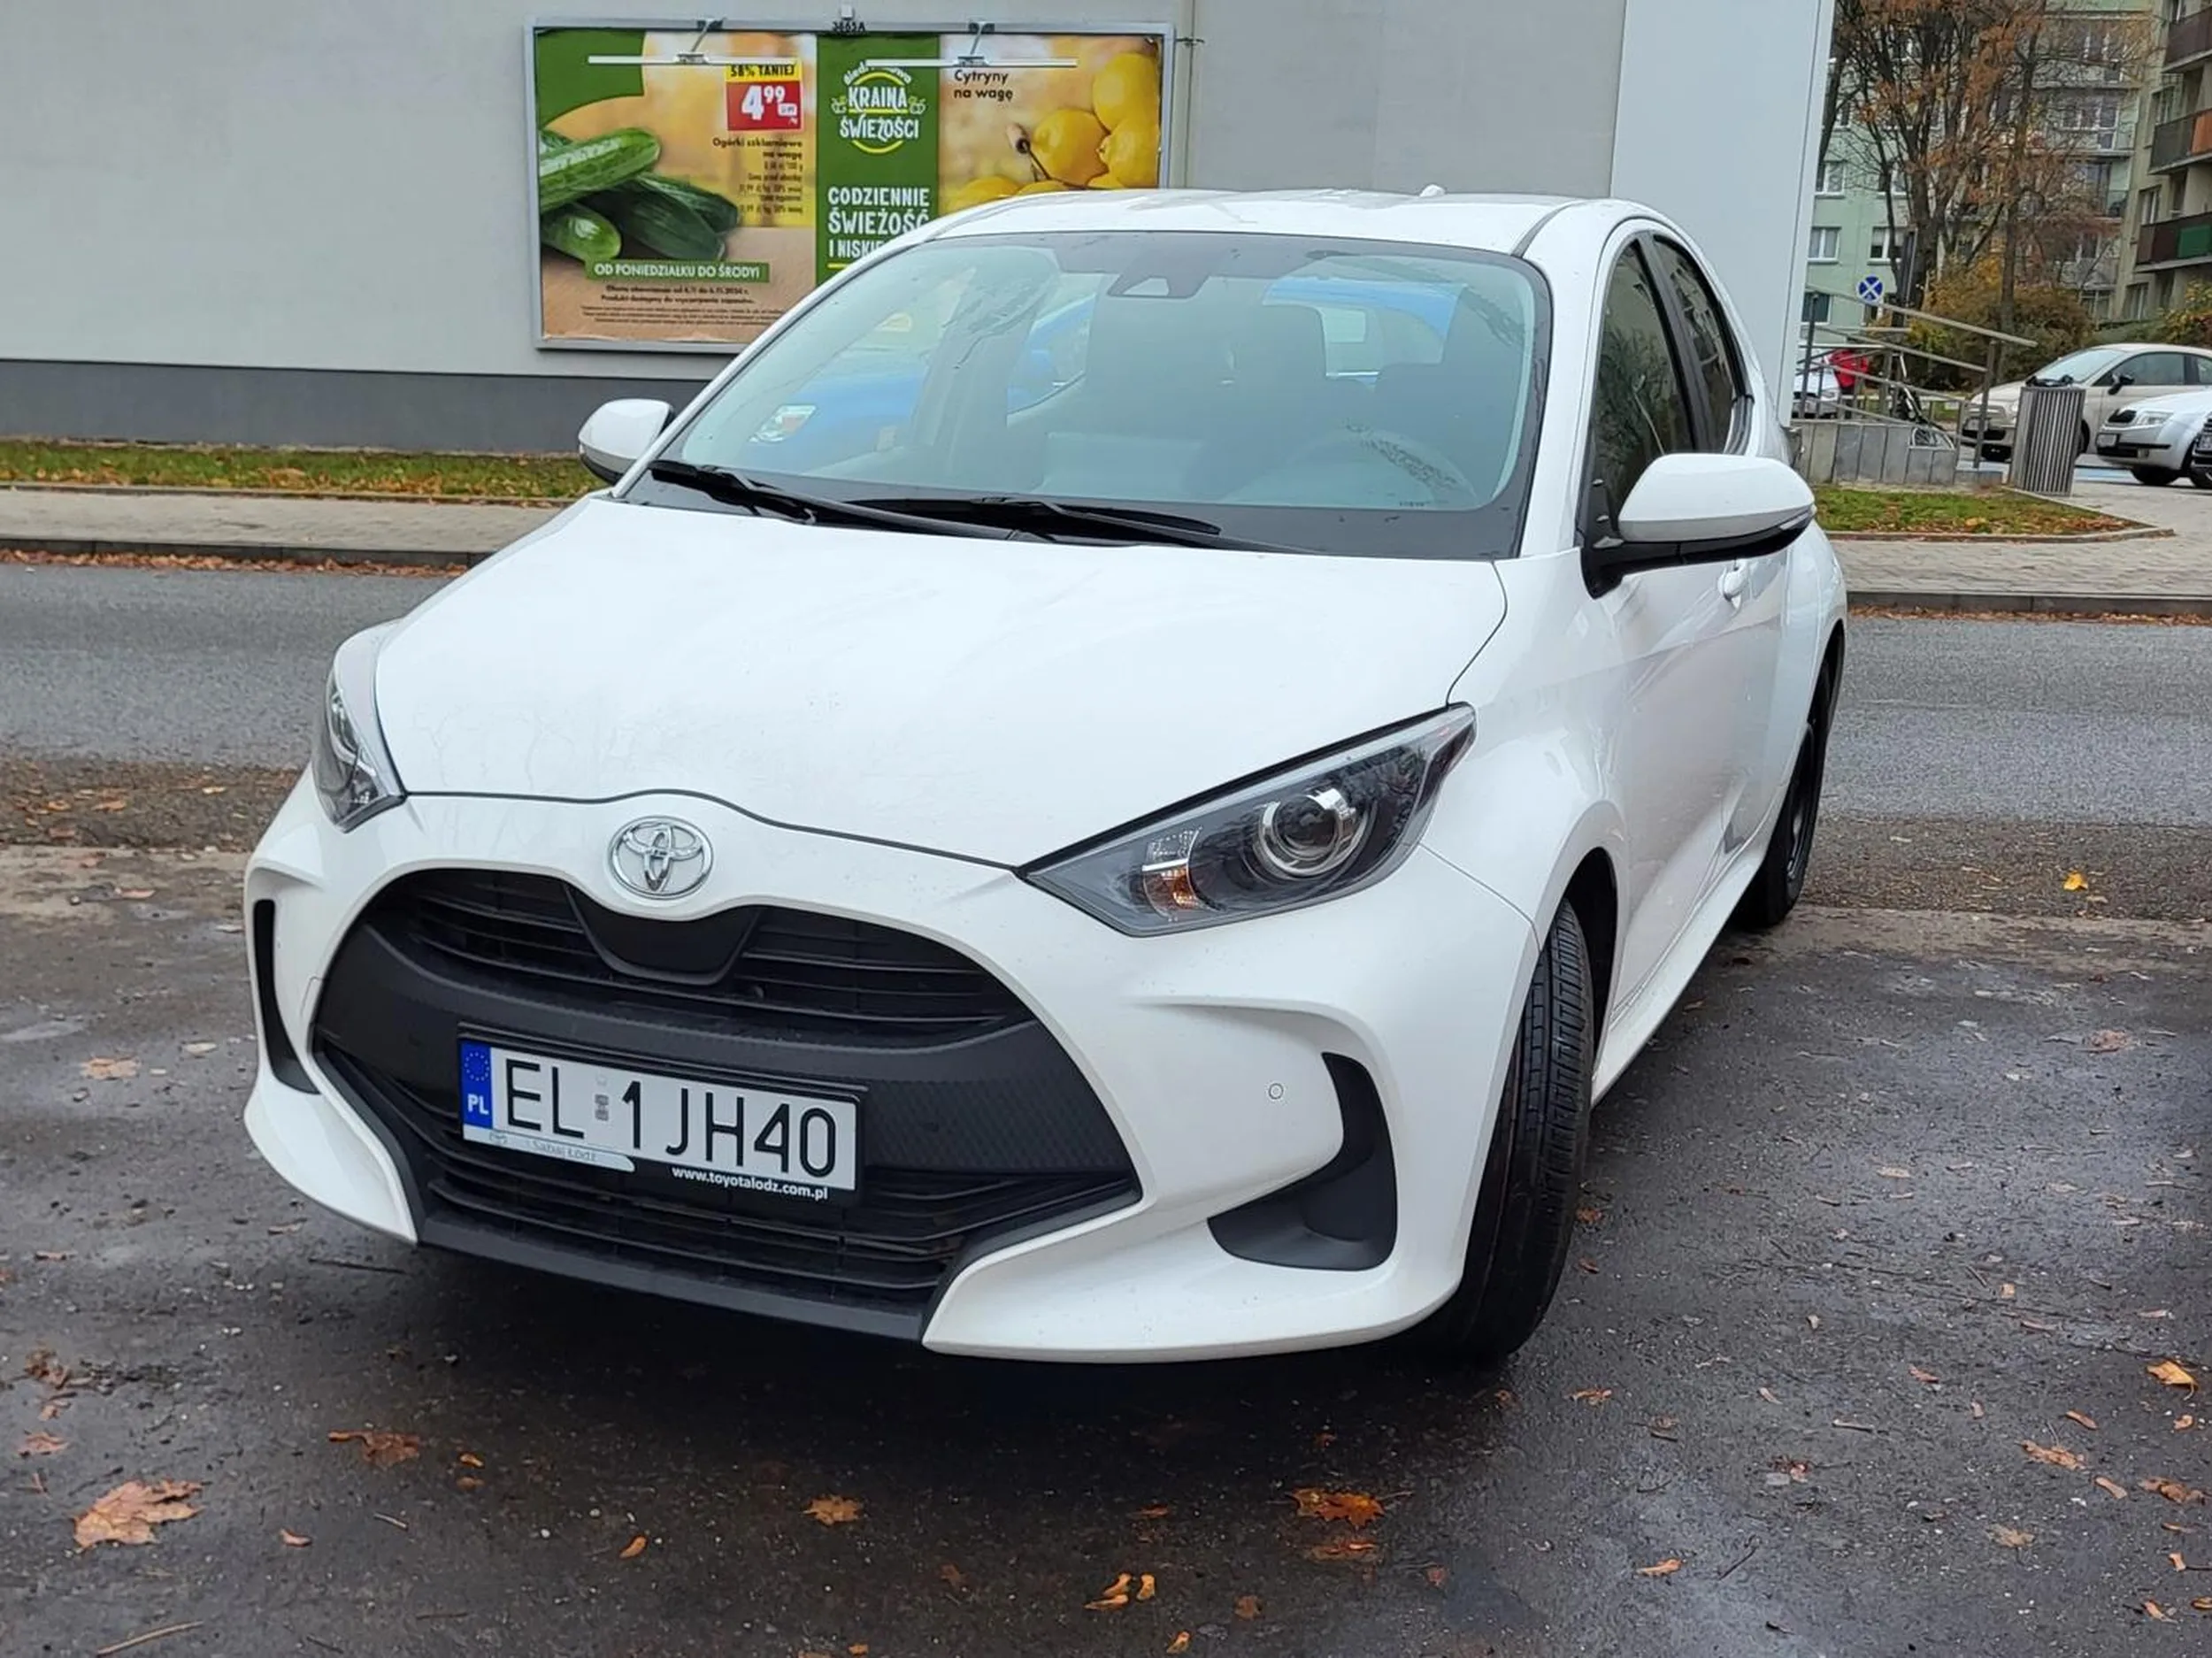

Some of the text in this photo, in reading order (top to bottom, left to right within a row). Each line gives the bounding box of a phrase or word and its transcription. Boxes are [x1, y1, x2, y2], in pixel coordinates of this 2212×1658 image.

[758, 64, 795, 76] TANIEJ
[955, 69, 1009, 85] Cytryny
[848, 86, 908, 112] KRAINA
[954, 89, 1013, 102] na wagę
[840, 113, 919, 142] ŚWIEŻOŚCI
[827, 187, 930, 207] CODZIENNIE
[829, 239, 834, 258] I
[594, 264, 612, 275] OD
[615, 264, 695, 277] PONIEDZIAŁKU
[697, 266, 717, 277] DO
[467, 1094, 489, 1115] PL
[506, 1058, 837, 1178] EL 1JH40
[672, 1167, 828, 1201] www.toyotalodz.com.pl
